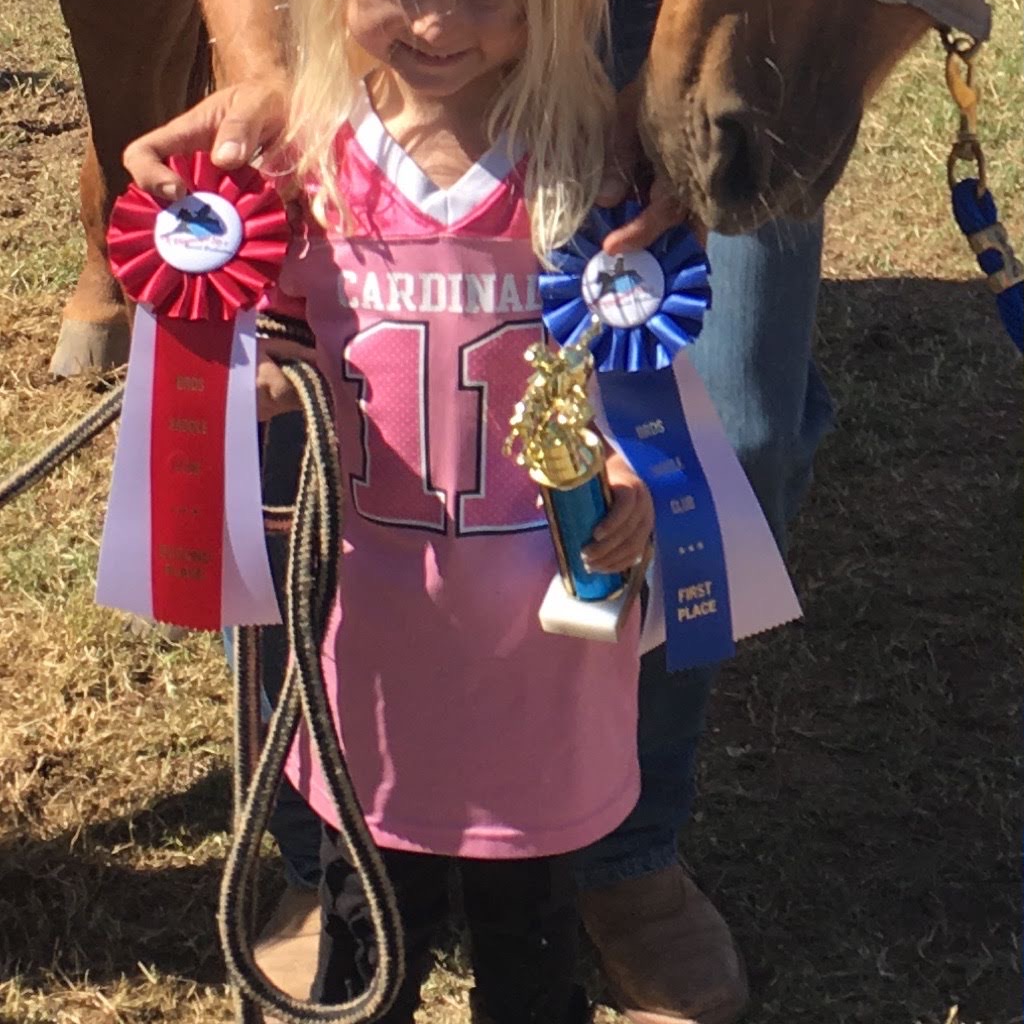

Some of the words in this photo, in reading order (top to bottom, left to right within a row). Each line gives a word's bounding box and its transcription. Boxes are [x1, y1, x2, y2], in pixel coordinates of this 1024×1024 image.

[344, 319, 548, 536] 11
[678, 581, 712, 603] FIRST
[677, 600, 717, 623] PLACE
